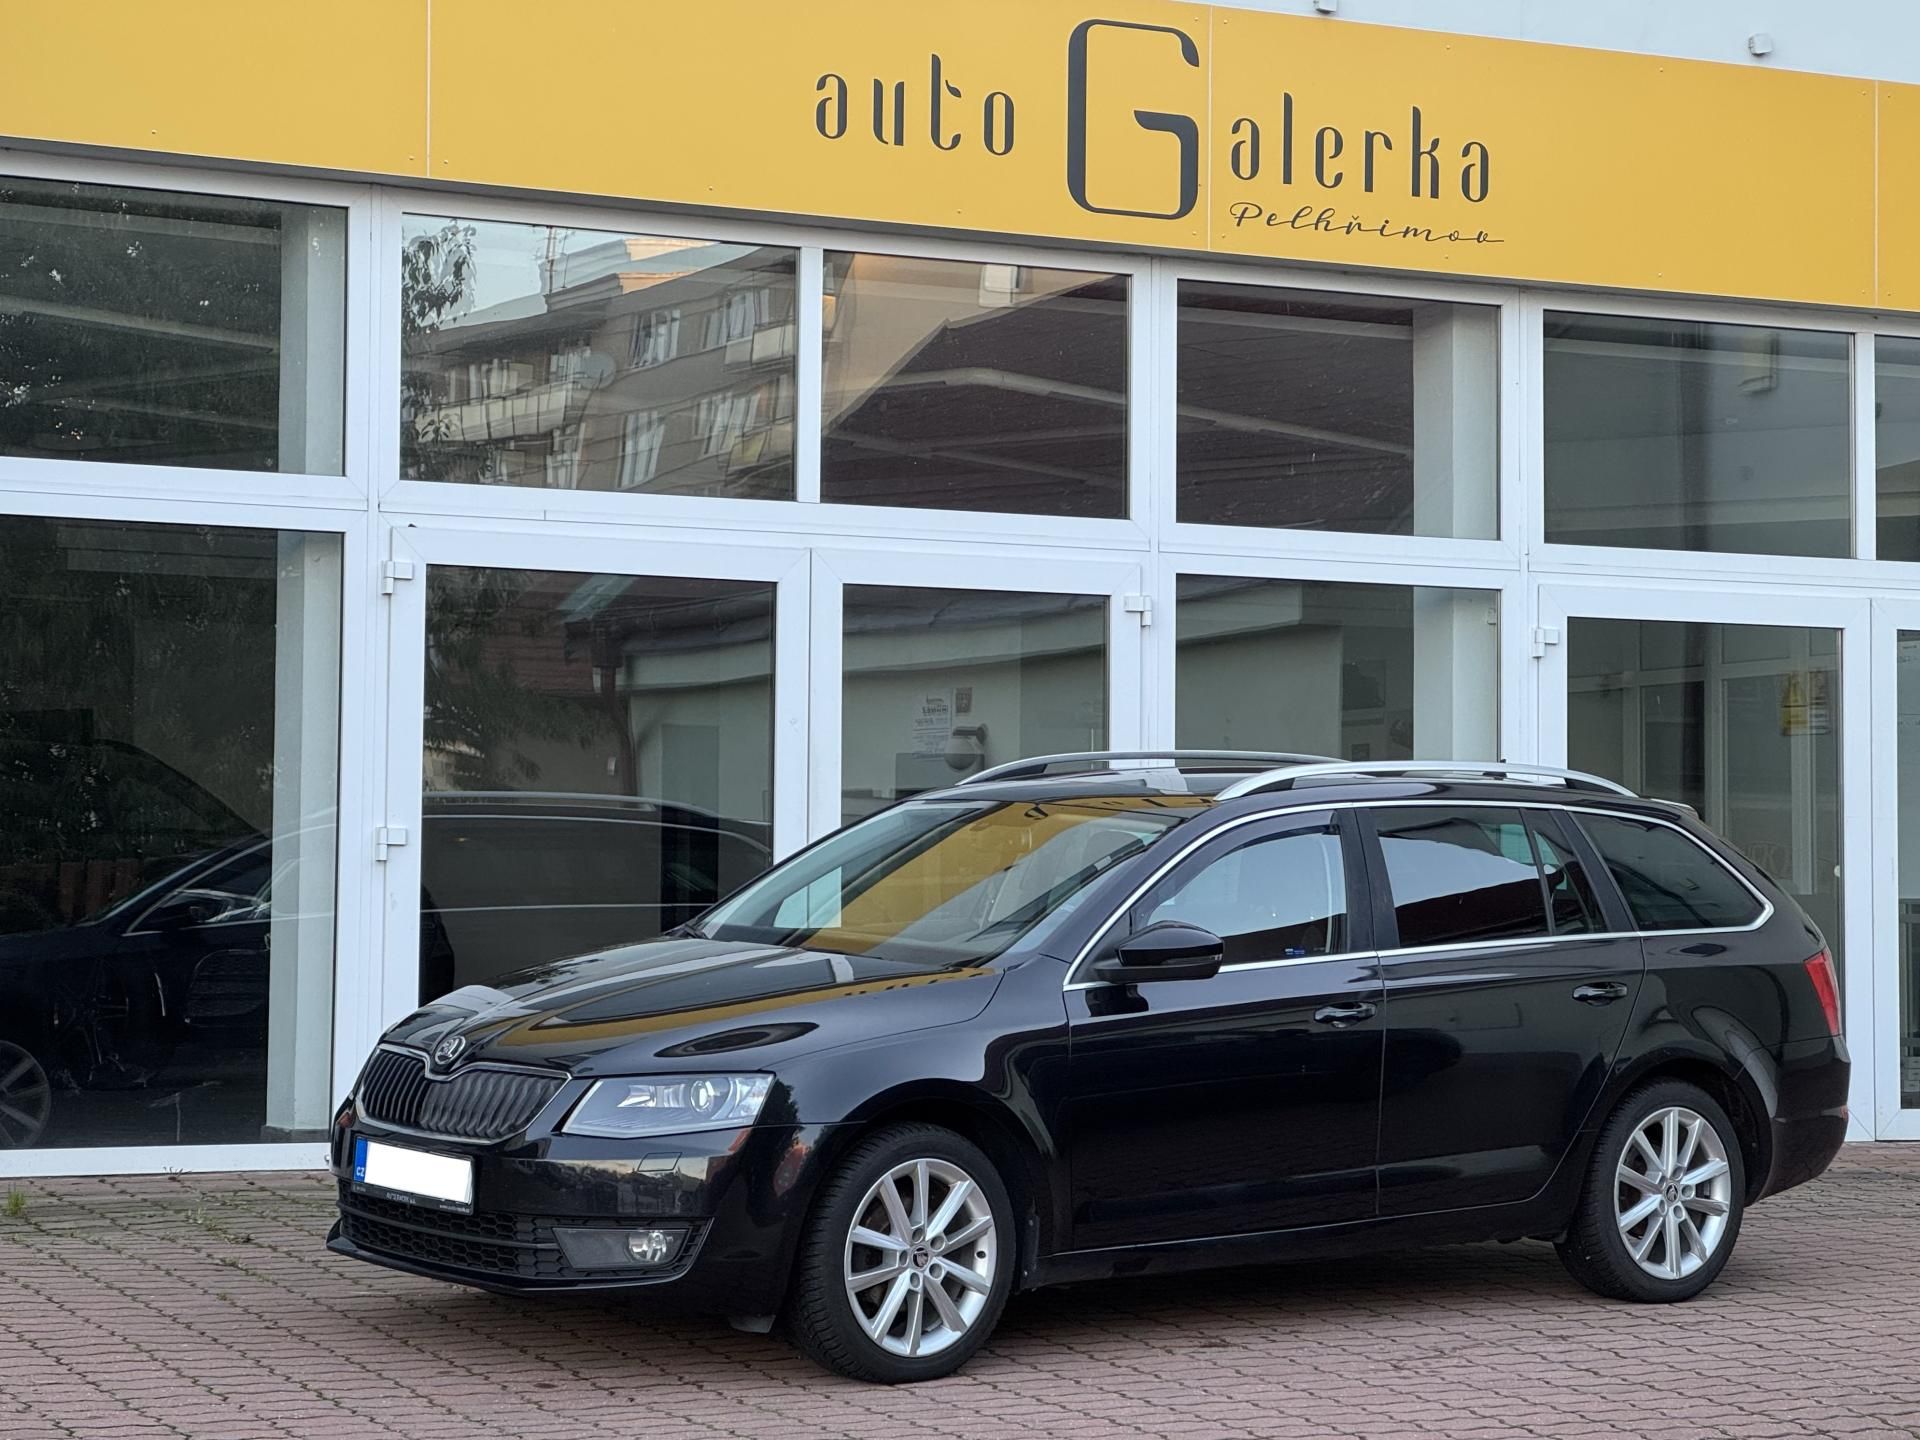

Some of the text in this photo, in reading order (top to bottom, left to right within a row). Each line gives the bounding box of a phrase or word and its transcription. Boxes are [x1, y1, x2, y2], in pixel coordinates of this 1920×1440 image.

[815, 18, 1489, 221] auto Galerka
[1229, 201, 1505, 244] Pelhřimov
[356, 1166, 365, 1177] CZ
